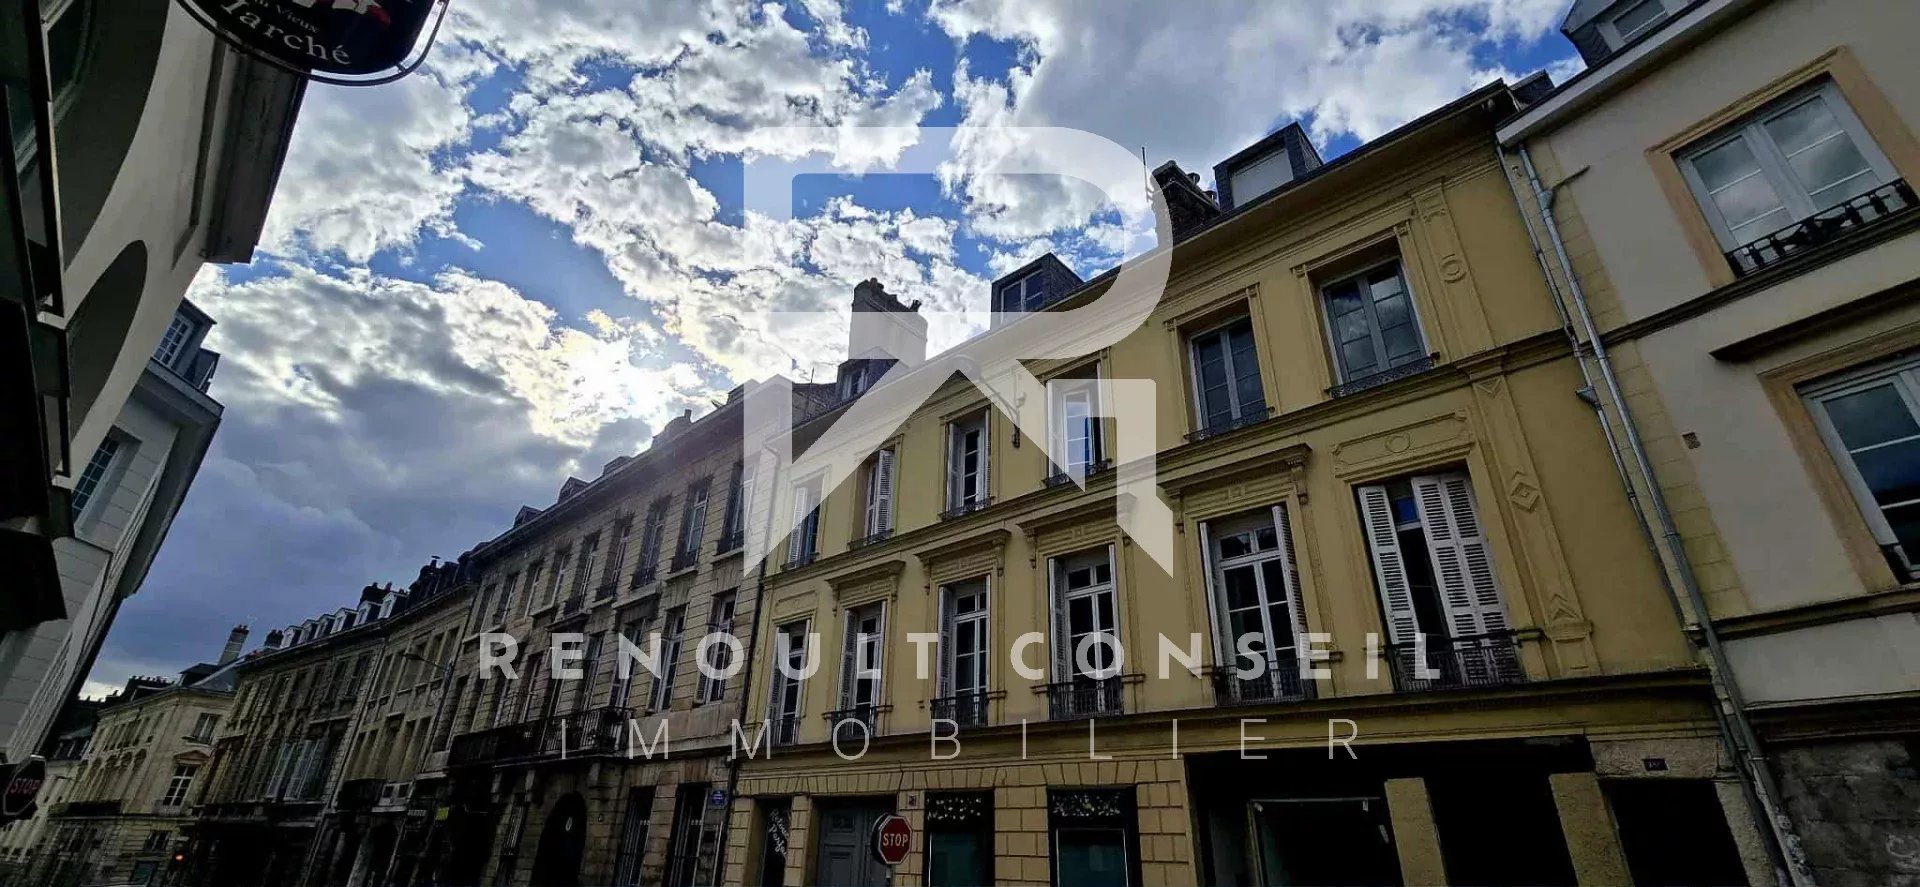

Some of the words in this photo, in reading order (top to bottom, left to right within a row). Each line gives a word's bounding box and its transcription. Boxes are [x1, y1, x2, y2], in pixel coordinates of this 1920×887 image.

[275, 3, 321, 34] Vieux
[10, 778, 41, 795] STOP
[882, 832, 909, 848] STOP
